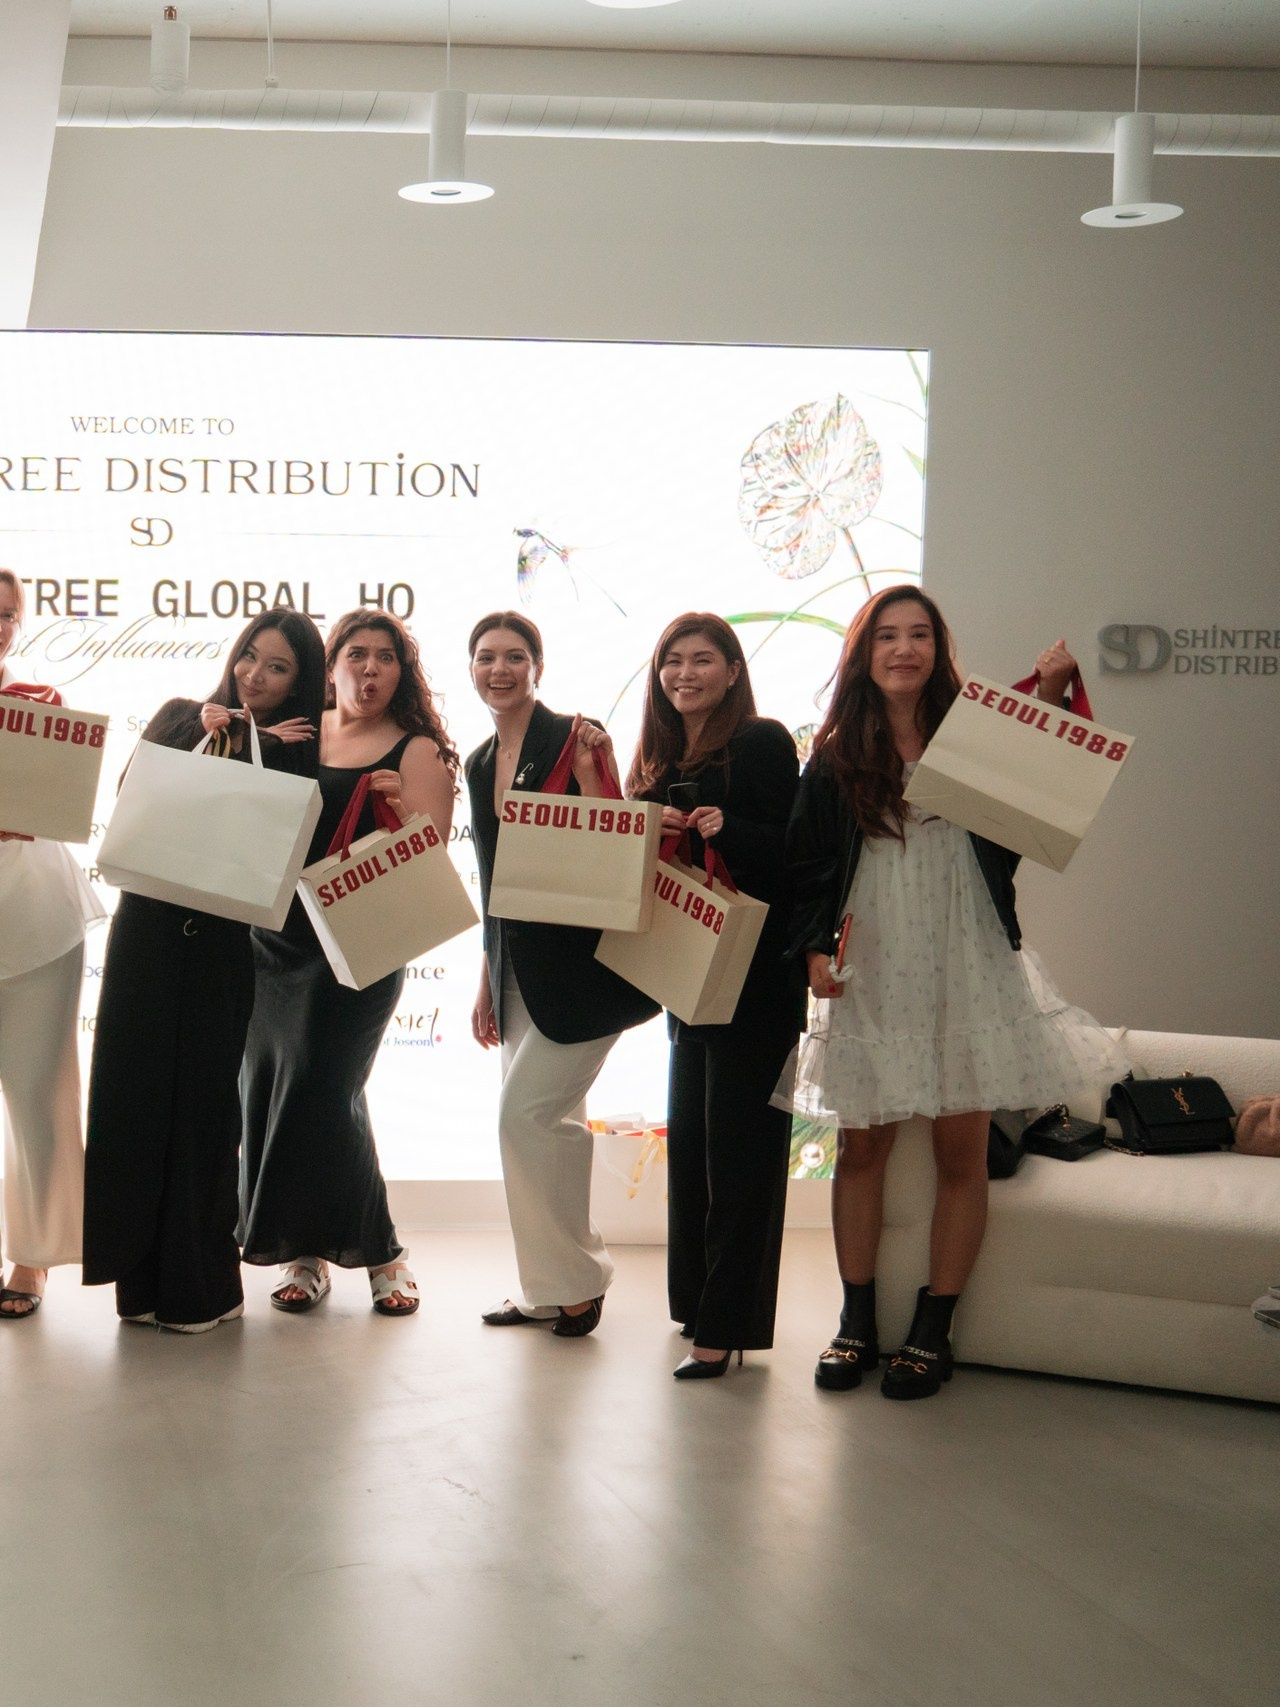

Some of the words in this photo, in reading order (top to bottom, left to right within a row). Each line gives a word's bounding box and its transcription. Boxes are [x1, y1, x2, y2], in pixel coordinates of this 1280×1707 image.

[70, 416, 195, 436] WELCOME
[202, 417, 235, 436] TO
[151, 579, 326, 619] GLOBAL
[1174, 655, 1279, 676] DISTRIB
